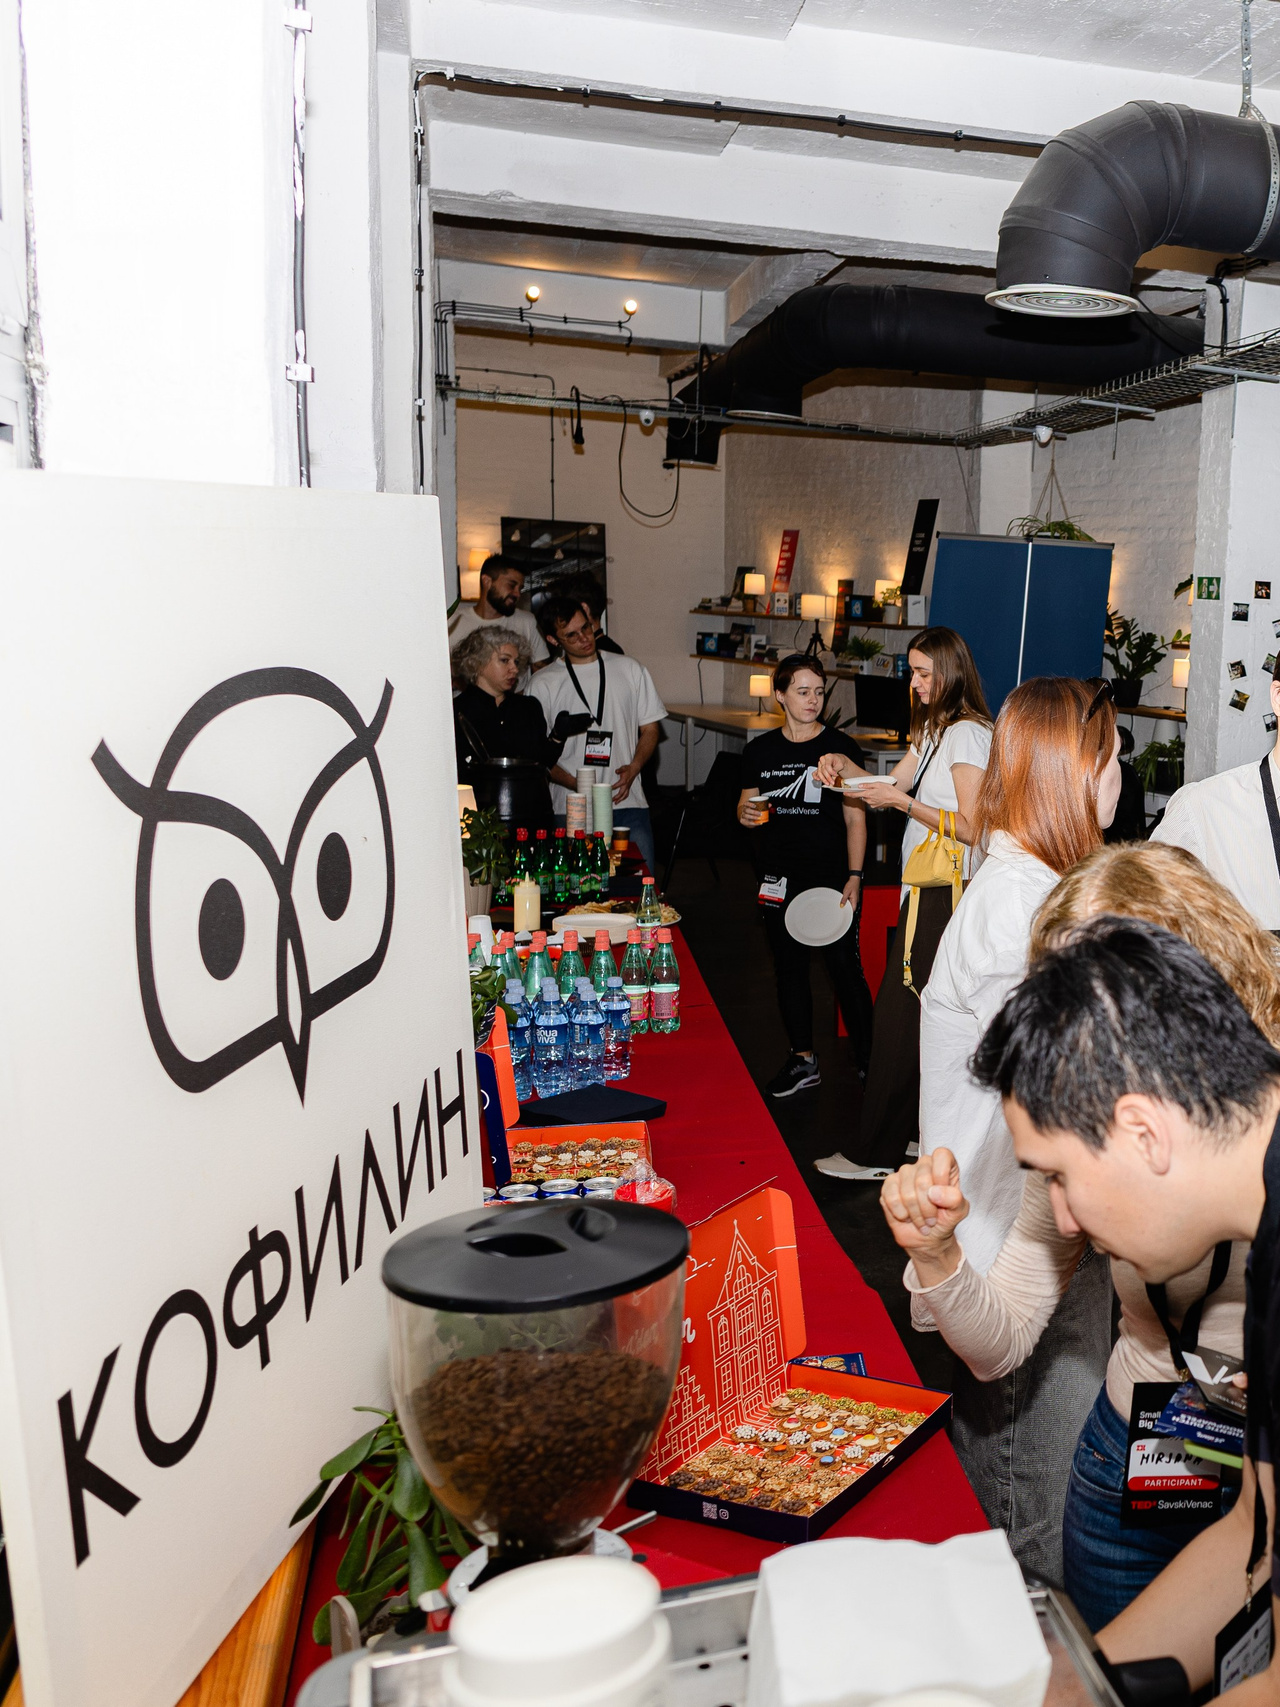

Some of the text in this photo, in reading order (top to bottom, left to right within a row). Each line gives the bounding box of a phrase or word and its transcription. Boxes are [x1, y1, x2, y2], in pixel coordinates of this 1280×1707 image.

[771, 769, 796, 778] impact
[57, 1048, 469, 1569] КОФИЛИН
[1139, 1410, 1161, 1419] Small
[1138, 1419, 1153, 1429] Big
[1144, 1478, 1203, 1487] PARTICIPANT
